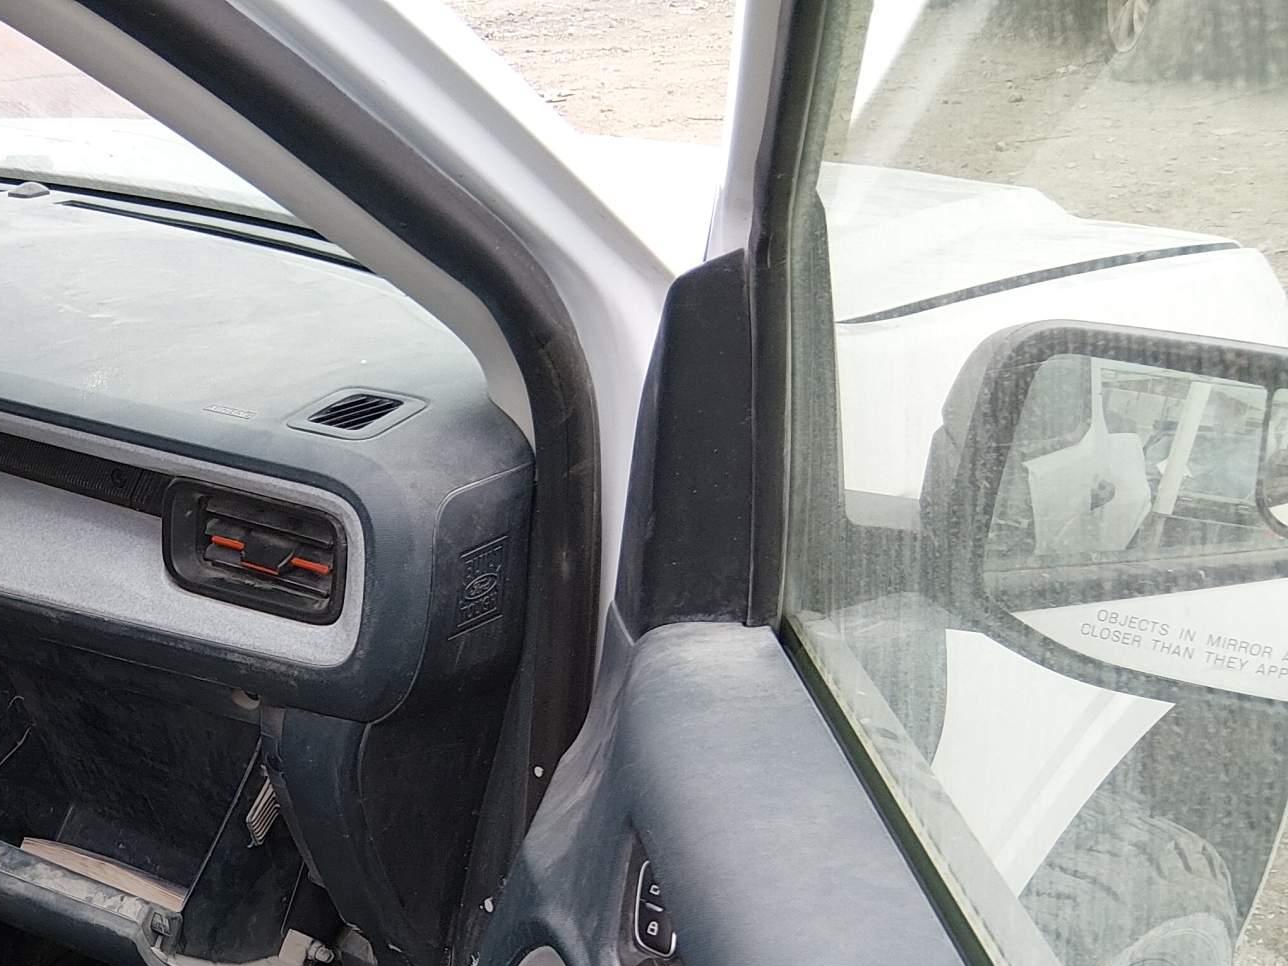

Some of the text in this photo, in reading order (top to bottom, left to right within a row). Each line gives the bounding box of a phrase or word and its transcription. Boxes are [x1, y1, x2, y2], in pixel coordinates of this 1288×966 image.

[1080, 623, 1142, 648] CLOSER
[1152, 638, 1196, 660] THAN
[1205, 650, 1249, 671] THEY
[1096, 609, 1170, 636] OBJECTS
[1178, 627, 1197, 642] IN
[1206, 633, 1273, 659] MIRROR
